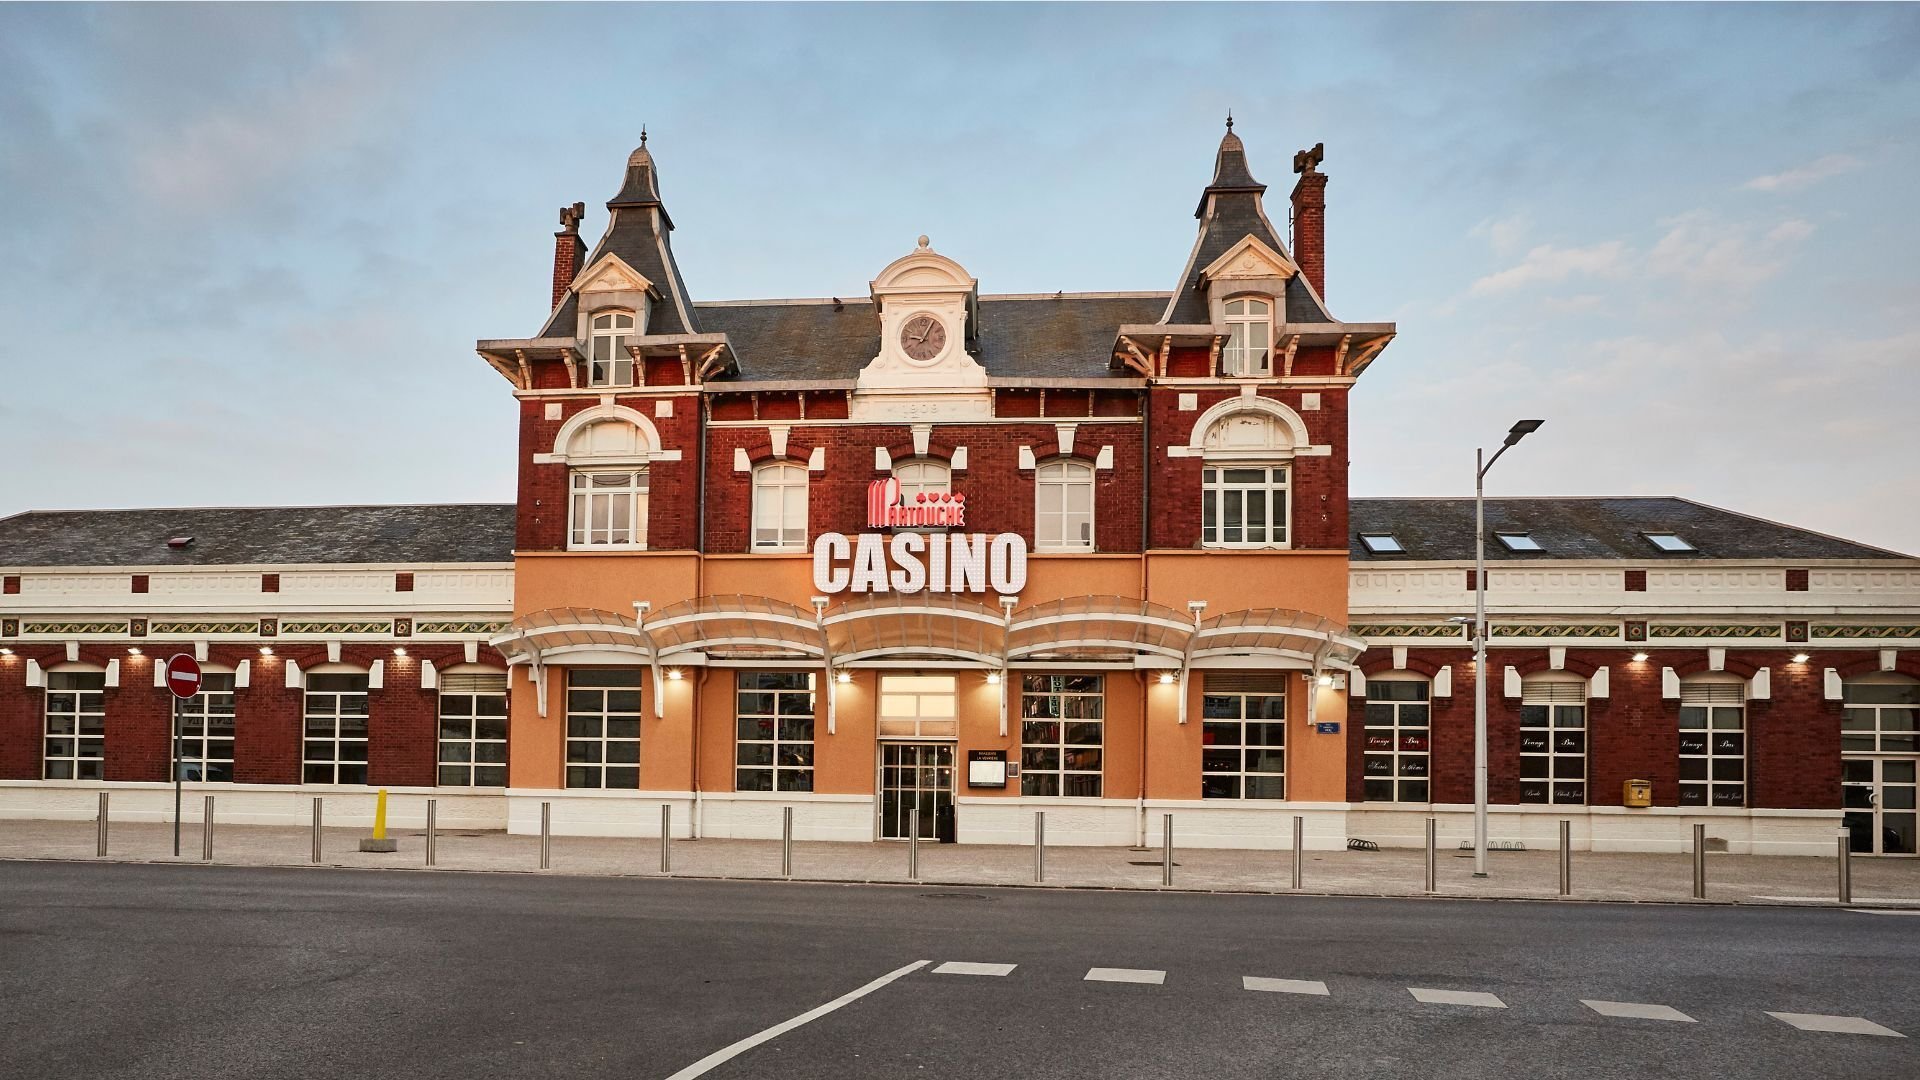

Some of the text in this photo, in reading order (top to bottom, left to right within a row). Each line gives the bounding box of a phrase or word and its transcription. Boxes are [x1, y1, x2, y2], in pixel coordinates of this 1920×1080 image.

[867, 477, 965, 528] PARTOUCHE
[813, 532, 1027, 594] CASINO
[1368, 736, 1419, 746] Lounge Bar
[1523, 738, 1575, 747] Lounge Bar
[1681, 740, 1734, 749] Lounge Bar
